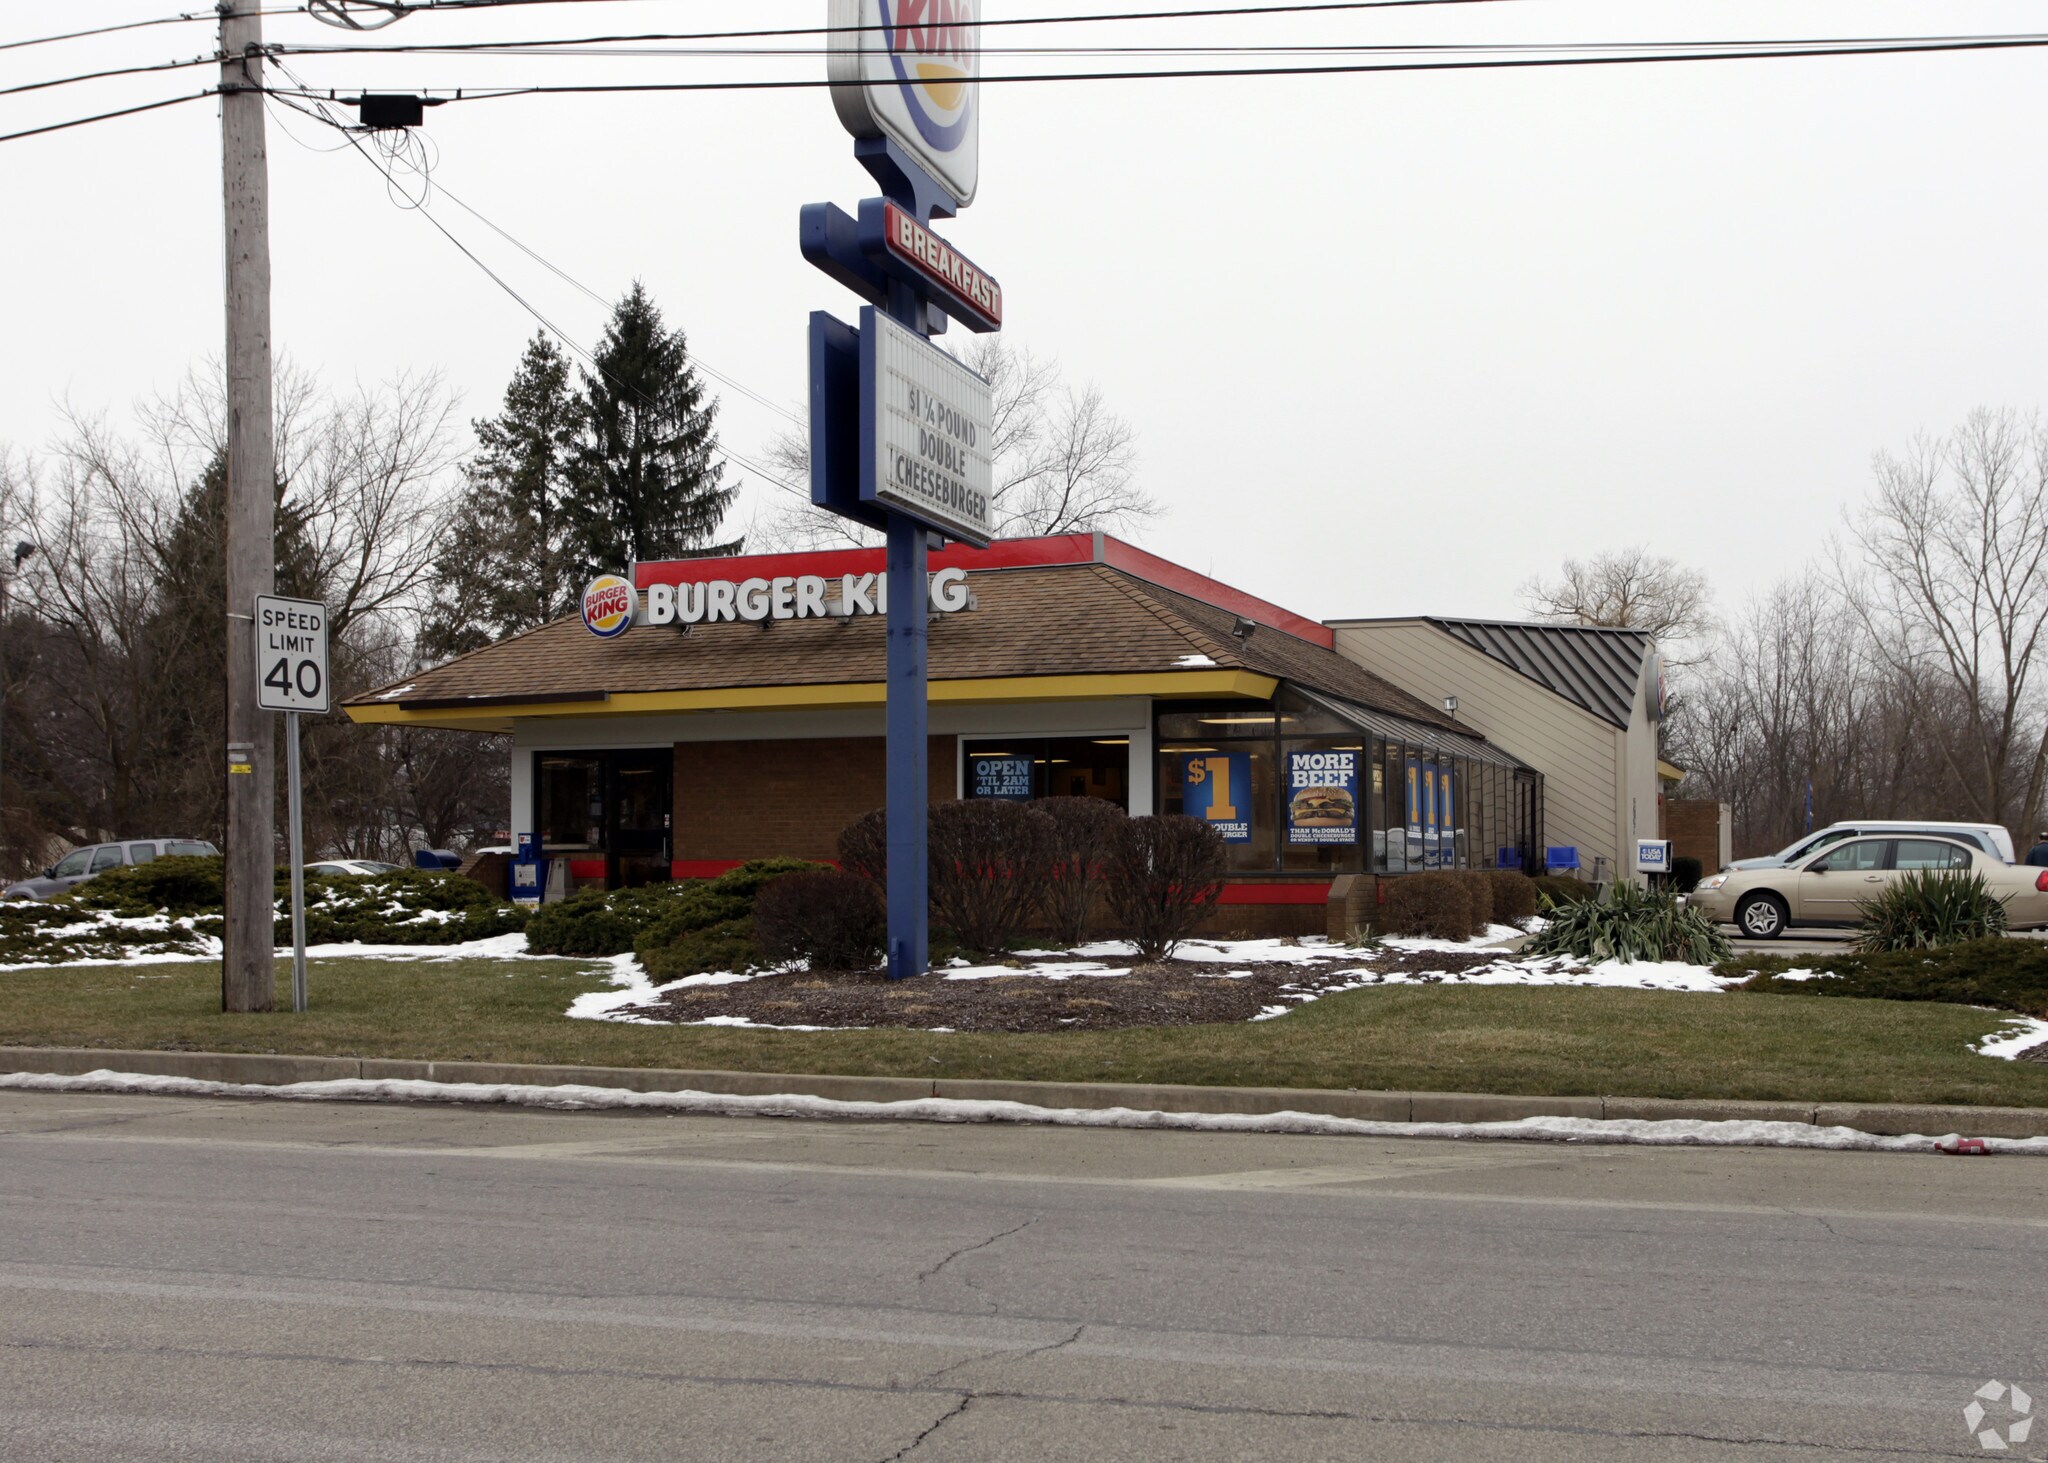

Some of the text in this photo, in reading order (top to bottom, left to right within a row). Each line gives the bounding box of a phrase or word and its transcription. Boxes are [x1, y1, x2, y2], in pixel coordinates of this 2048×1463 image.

[899, 213, 998, 314] BREAKFAST
[910, 386, 919, 418] $1
[938, 402, 975, 448] POUND
[920, 427, 965, 478] DOUBLE
[896, 454, 986, 523] CHEESEBURGER
[586, 586, 627, 608] BURGER
[648, 567, 968, 625] BURGER KIG
[263, 609, 320, 631] SPEED
[587, 596, 628, 624] KING
[269, 633, 314, 653] LIMIT
[264, 657, 321, 698] 40
[976, 760, 1029, 776] OPEN
[1292, 754, 1353, 770] MORE
[1002, 776, 1029, 786] 2AM
[1188, 757, 1236, 820] $1
[1292, 770, 1353, 787] BEEF
[976, 786, 1029, 795] OR LATER
[1211, 823, 1248, 832] OUBLE
